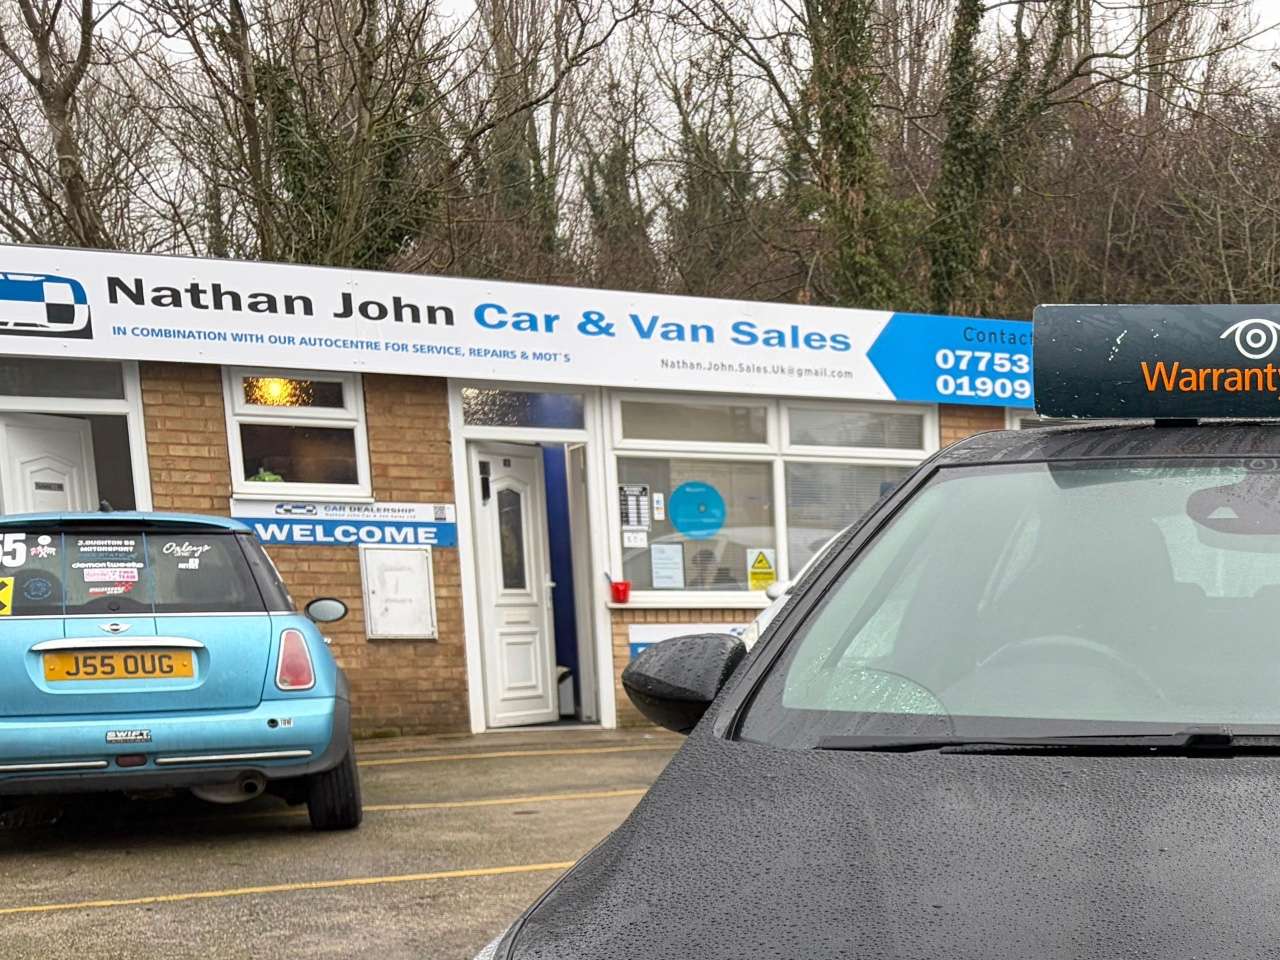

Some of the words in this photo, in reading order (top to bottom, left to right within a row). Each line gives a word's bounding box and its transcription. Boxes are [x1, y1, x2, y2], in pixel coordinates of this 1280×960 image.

[106, 276, 314, 316] Nathan
[333, 292, 454, 326] John
[473, 302, 560, 333] Car
[577, 310, 615, 338] &
[629, 314, 715, 343] Van
[730, 320, 852, 352] Sales
[112, 326, 127, 337] IN
[131, 327, 228, 341] COMBINATION
[230, 332, 265, 344] WITH
[268, 334, 296, 346] OUR
[299, 337, 381, 352] AUTOCENTRE
[385, 341, 409, 352] FOR
[412, 343, 466, 357] SERVICE,
[469, 347, 516, 359] REPAIRS
[520, 351, 529, 360] &
[935, 348, 1030, 374] 07753
[936, 374, 1031, 399] 01909
[324, 504, 346, 512] CAR
[254, 523, 439, 544] WELCOME
[0, 533, 26, 567] 5
[65, 654, 115, 677] J55
[123, 654, 174, 675] OUG
